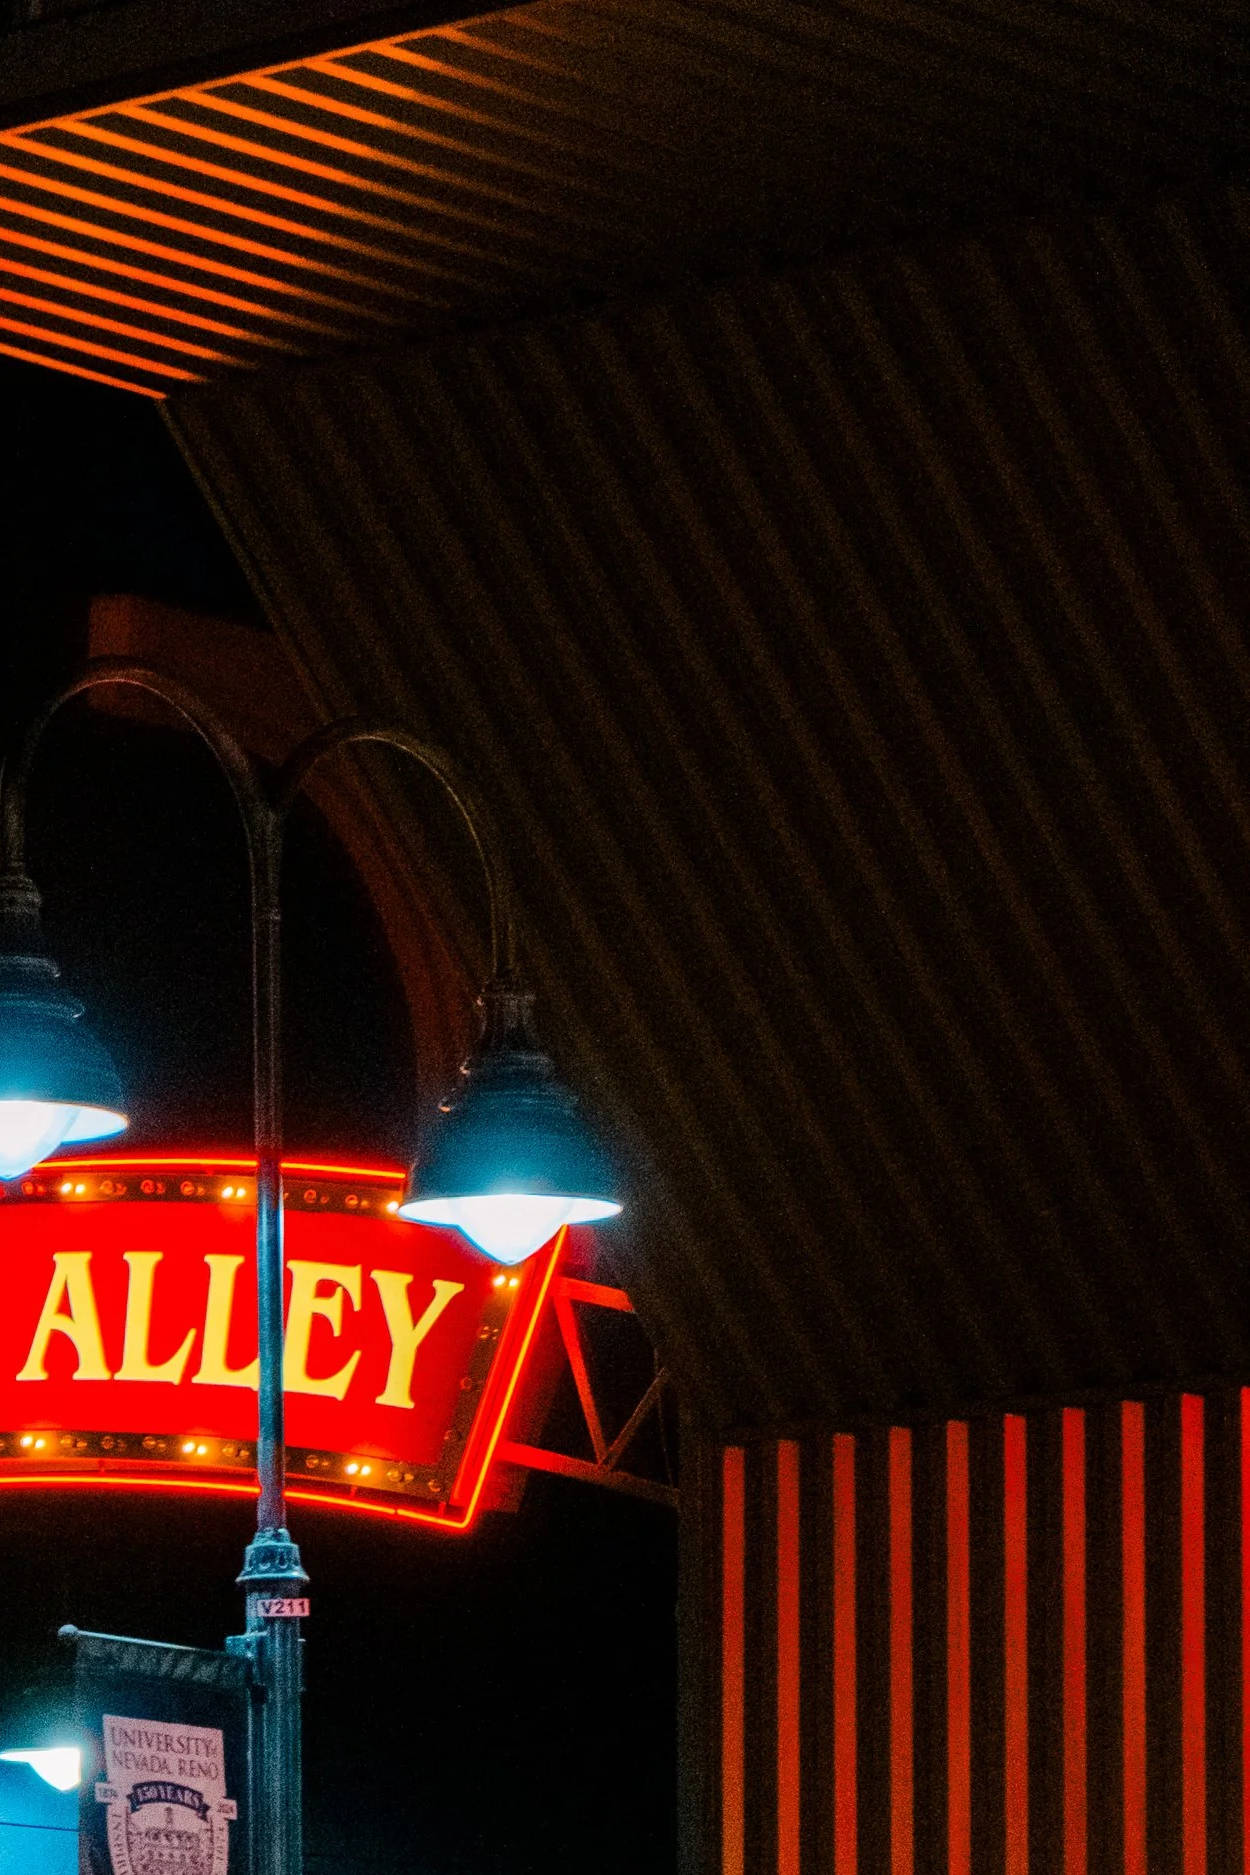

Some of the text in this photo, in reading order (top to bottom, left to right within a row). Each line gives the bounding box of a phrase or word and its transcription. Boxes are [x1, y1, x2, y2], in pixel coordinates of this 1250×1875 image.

[16, 1251, 465, 1409] ALLEY
[261, 1600, 305, 1614] V211
[111, 1726, 213, 1758] UNIVERSITY
[177, 1757, 220, 1781] RENO
